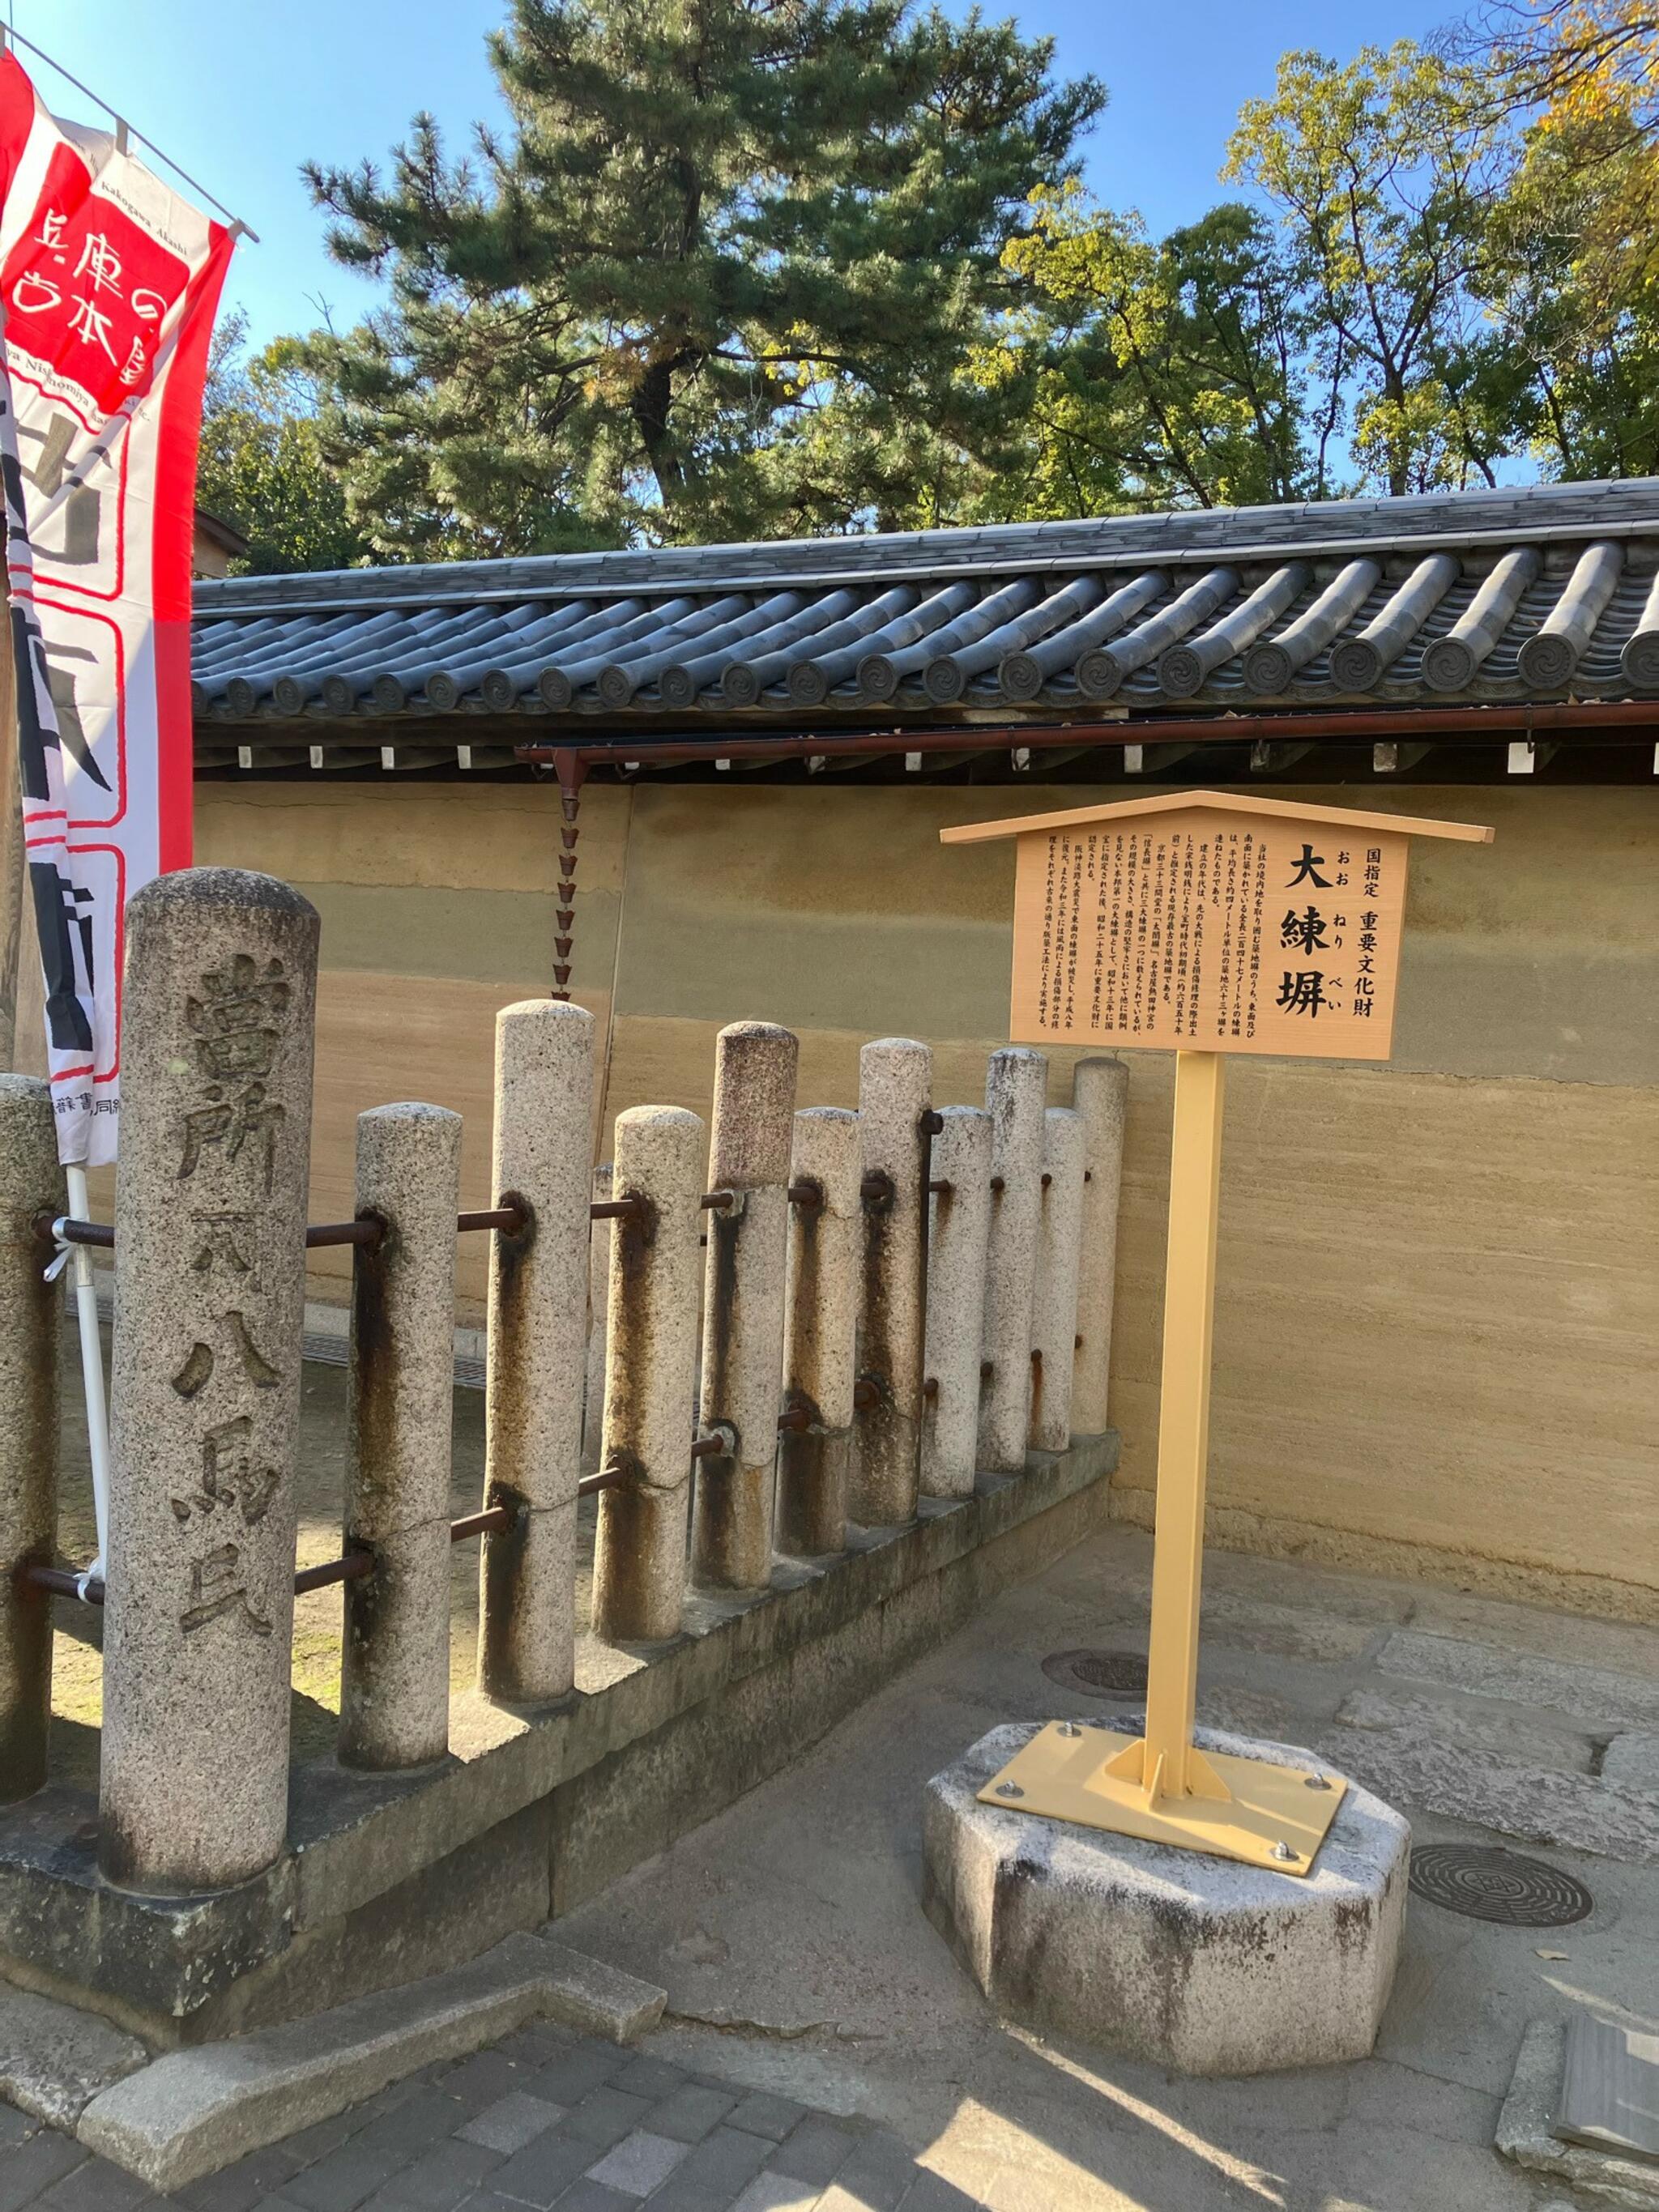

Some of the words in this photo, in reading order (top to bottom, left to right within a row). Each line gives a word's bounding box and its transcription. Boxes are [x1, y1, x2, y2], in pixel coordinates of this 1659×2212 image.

[101, 181, 151, 228] Kakogawa
[156, 228, 188, 256] Akashi
[1087, 835, 1097, 881] 認定される。
[1211, 833, 1224, 908] 連ねたものである。
[1335, 850, 1350, 886] おお
[1363, 847, 1381, 898] 国指定
[1275, 843, 1334, 1019] 大練塀
[1333, 913, 1347, 950] ねり
[1352, 910, 1380, 1018] 重要文化財
[1328, 977, 1344, 1011] べい
